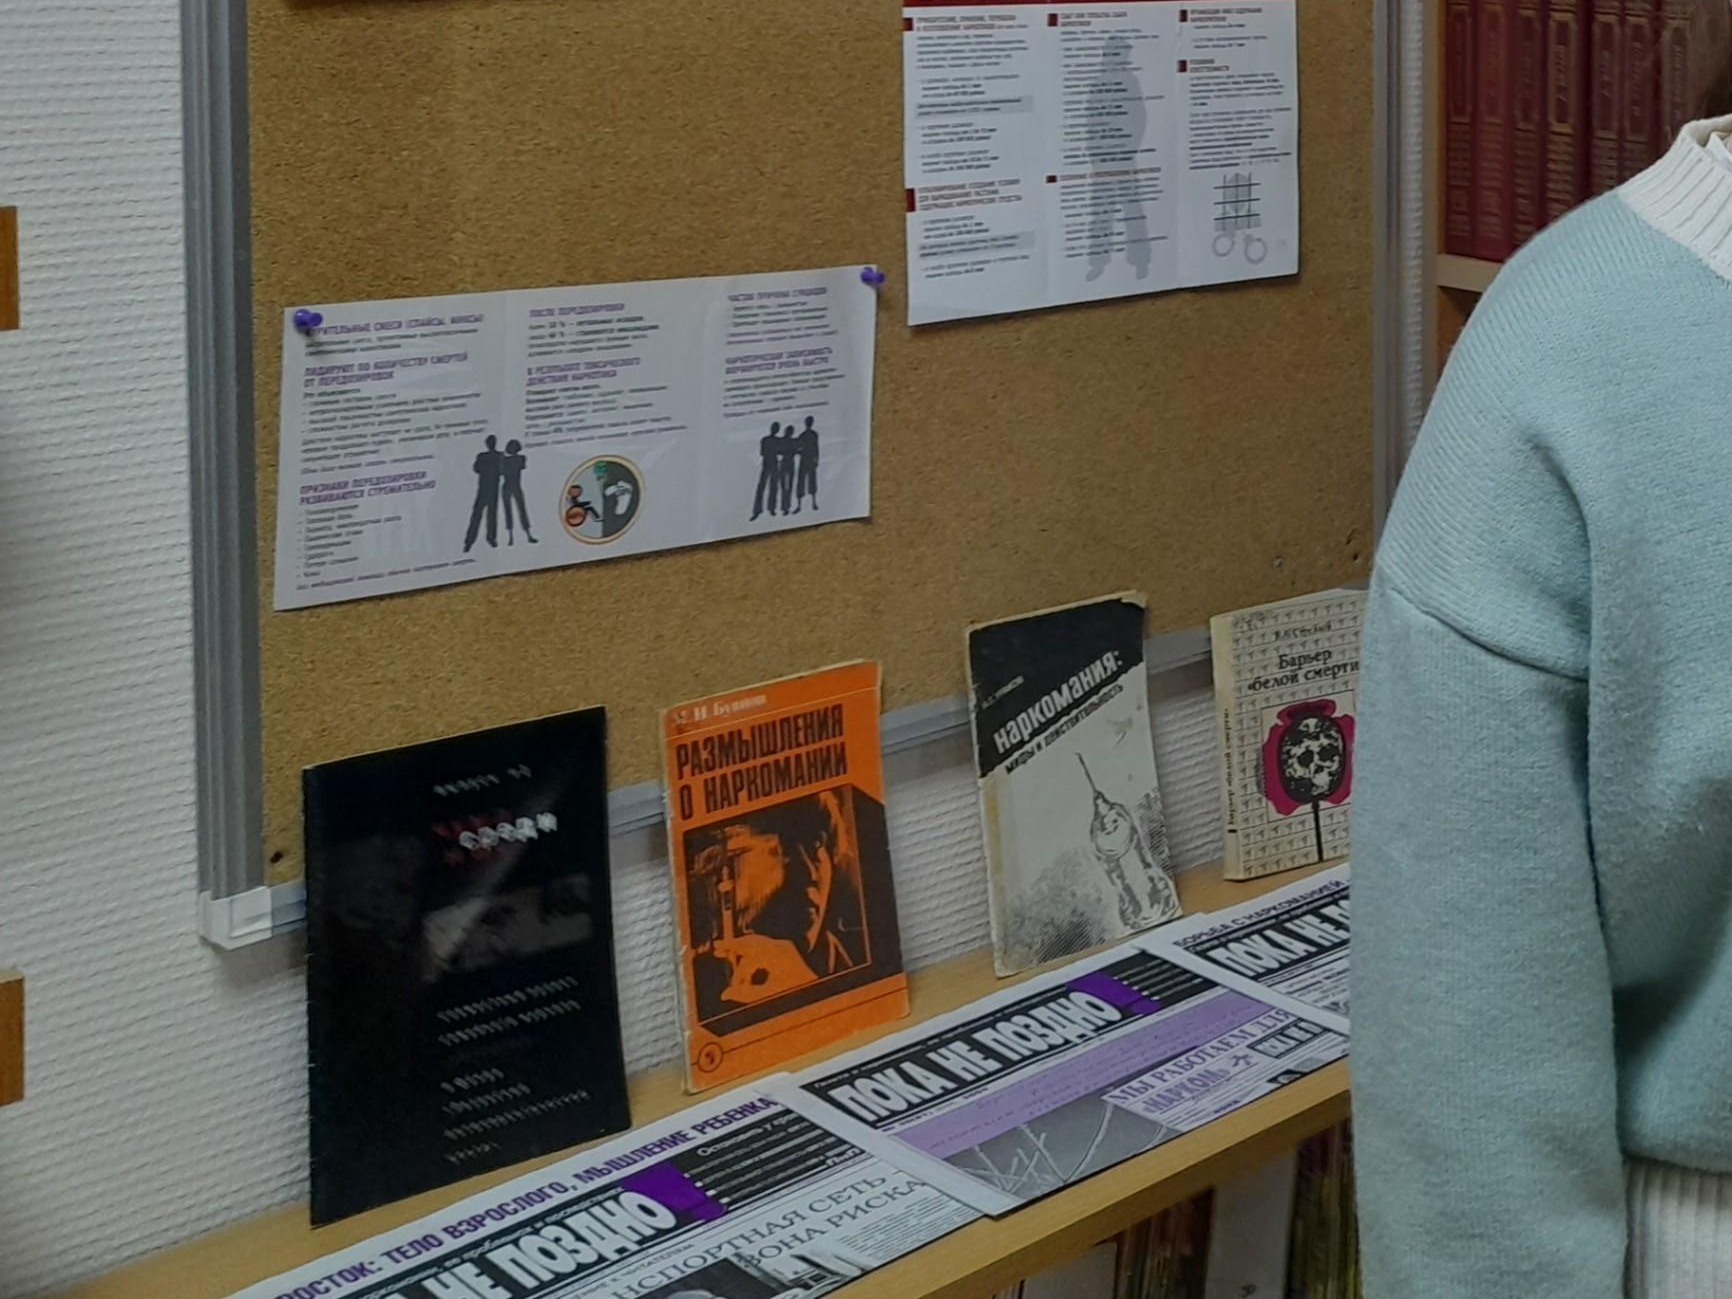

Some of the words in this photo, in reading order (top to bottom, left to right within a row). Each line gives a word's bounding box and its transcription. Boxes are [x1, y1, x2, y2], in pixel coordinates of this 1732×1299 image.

[1278, 649, 1332, 670] Барьер
[1304, 659, 1360, 682] смерти
[675, 703, 844, 781] РАЗМЫШЛЕНИЯ
[679, 783, 694, 821] О
[703, 741, 848, 814] НАРКОМАНИИ
[1205, 929, 1318, 977] ПОКА
[1284, 913, 1345, 948] НЕ
[832, 1049, 958, 1122] ПОКА
[932, 1033, 1002, 1080] НЕ
[980, 988, 1124, 1064] ПОЗДНО
[1102, 1076, 1155, 1105] МЫ
[1150, 1026, 1262, 1091] РАБОТАЕМ
[1247, 1007, 1296, 1036] ДЛЯ
[383, 1233, 444, 1267] ТЕЛО
[441, 1179, 579, 1241] ВЗРОСЛОГО,
[573, 1127, 697, 1184] МЫШЛЕНИЕ
[693, 1095, 780, 1137] РЕБЕНКА
[808, 1173, 888, 1214] СЕТЬ
[825, 1178, 929, 1230] РИСКА
[486, 1191, 679, 1288] ПОЗДНО
